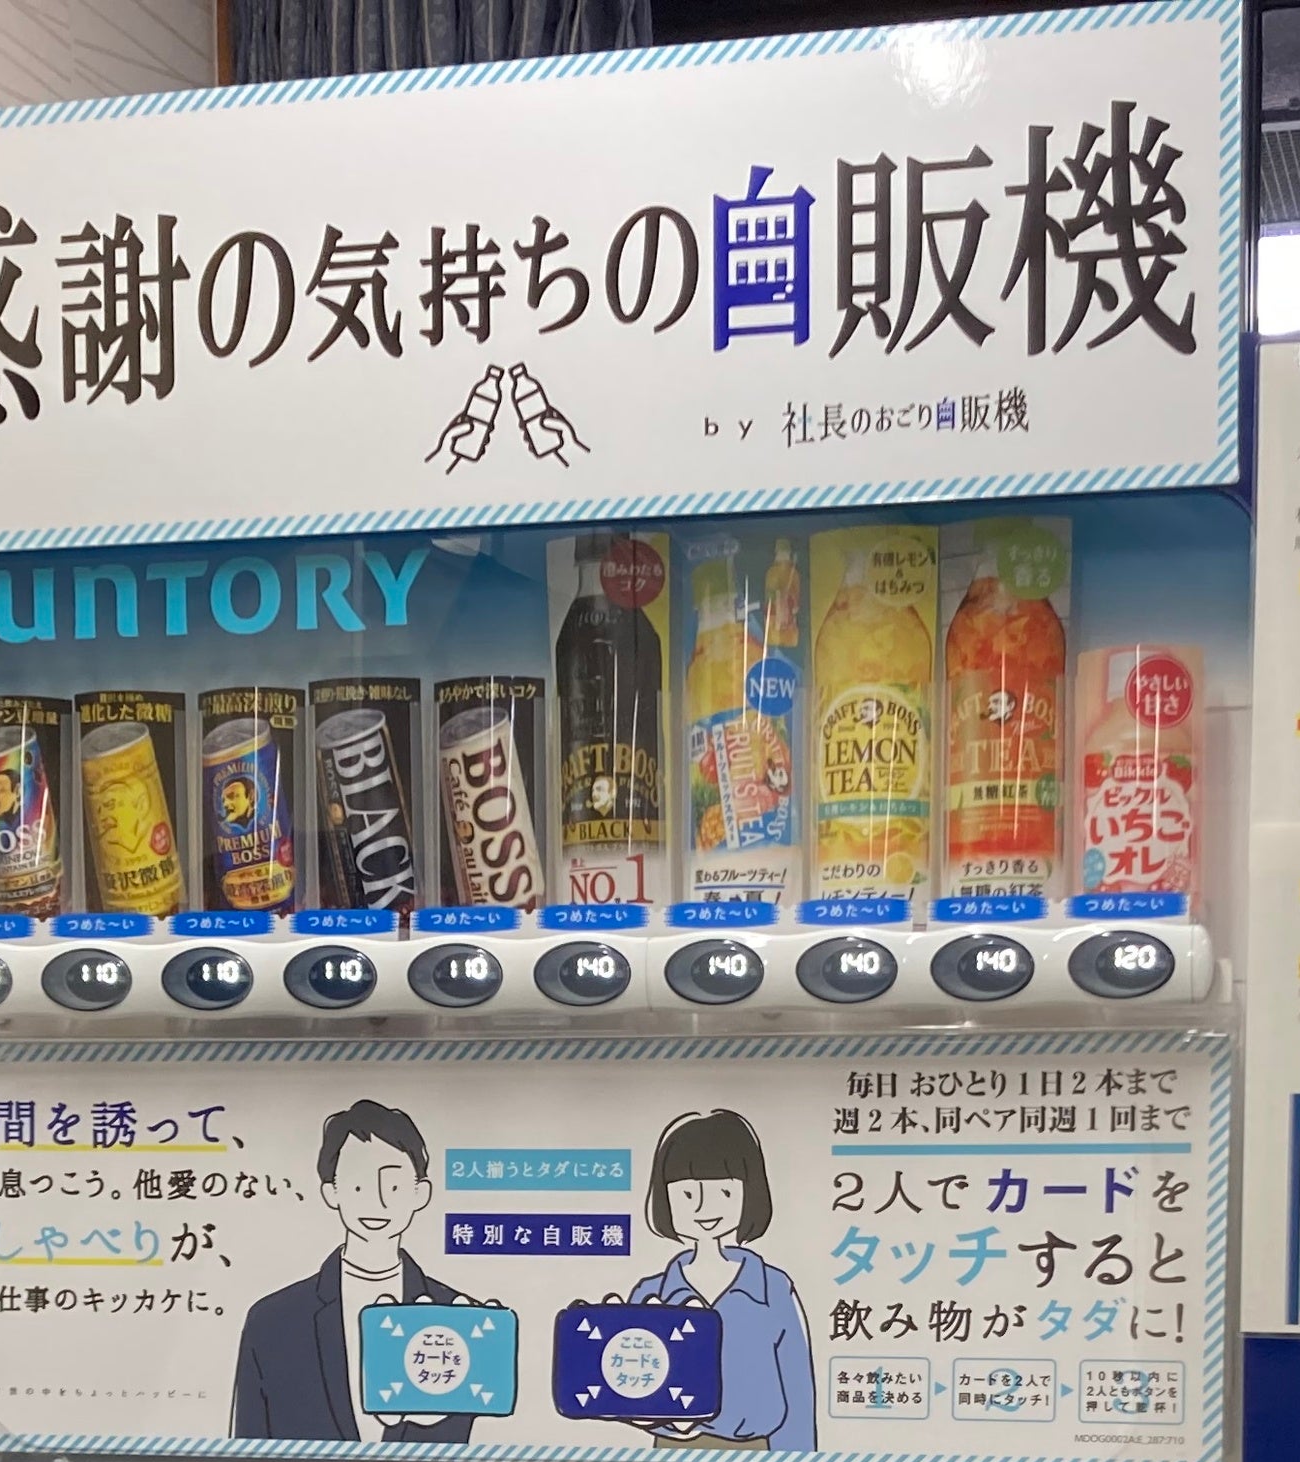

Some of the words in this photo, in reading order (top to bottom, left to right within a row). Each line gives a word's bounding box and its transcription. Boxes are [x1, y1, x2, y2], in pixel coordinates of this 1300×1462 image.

[781, 388, 1031, 449] 社長のおごり自販機
[875, 579, 925, 595] はちみつ
[749, 677, 796, 700] NEW
[1134, 675, 1188, 691] やさしい
[823, 700, 857, 740] CRAFT
[886, 700, 921, 737] BOSS
[824, 738, 917, 767] LEMON
[965, 739, 1044, 775] TEA
[826, 766, 877, 795] TEA
[1105, 787, 1172, 808] ビックル
[333, 729, 415, 910] BLACK
[463, 738, 533, 909] BOSS
[1089, 808, 1191, 846] いちご
[579, 821, 633, 841] BLACK
[232, 846, 270, 864] BOSS
[1107, 846, 1167, 878] オレ
[822, 862, 881, 882] こだわりの
[962, 859, 1039, 876] すっきり香る
[576, 954, 615, 978] 140
[708, 952, 747, 977] 140
[840, 950, 880, 975] 140
[976, 948, 1017, 973] 140
[1114, 944, 1155, 969] 120
[81, 962, 118, 983] 110
[201, 961, 239, 983] 110
[324, 960, 362, 981] 110
[449, 957, 488, 980] 110
[452, 1159, 625, 1181] 2人揃うとタダになる
[832, 1167, 1191, 1214] 2人でカードを
[452, 1222, 624, 1247] 特別な自販機
[832, 1226, 1187, 1288] タッチすると
[829, 1297, 1185, 1344] 飲み物がタダに!
[421, 1333, 455, 1348] ここに
[619, 1336, 654, 1351] ここに
[412, 1348, 462, 1367] カードを
[609, 1352, 662, 1371] カードを
[418, 1368, 457, 1385] タッチ
[616, 1371, 657, 1388] タッチ
[837, 1371, 923, 1386] 各々飲みたい
[958, 1373, 1052, 1387] カードを2人で
[837, 1391, 923, 1405] 商品を決める
[958, 1393, 1050, 1407] 同時にタッチ!
